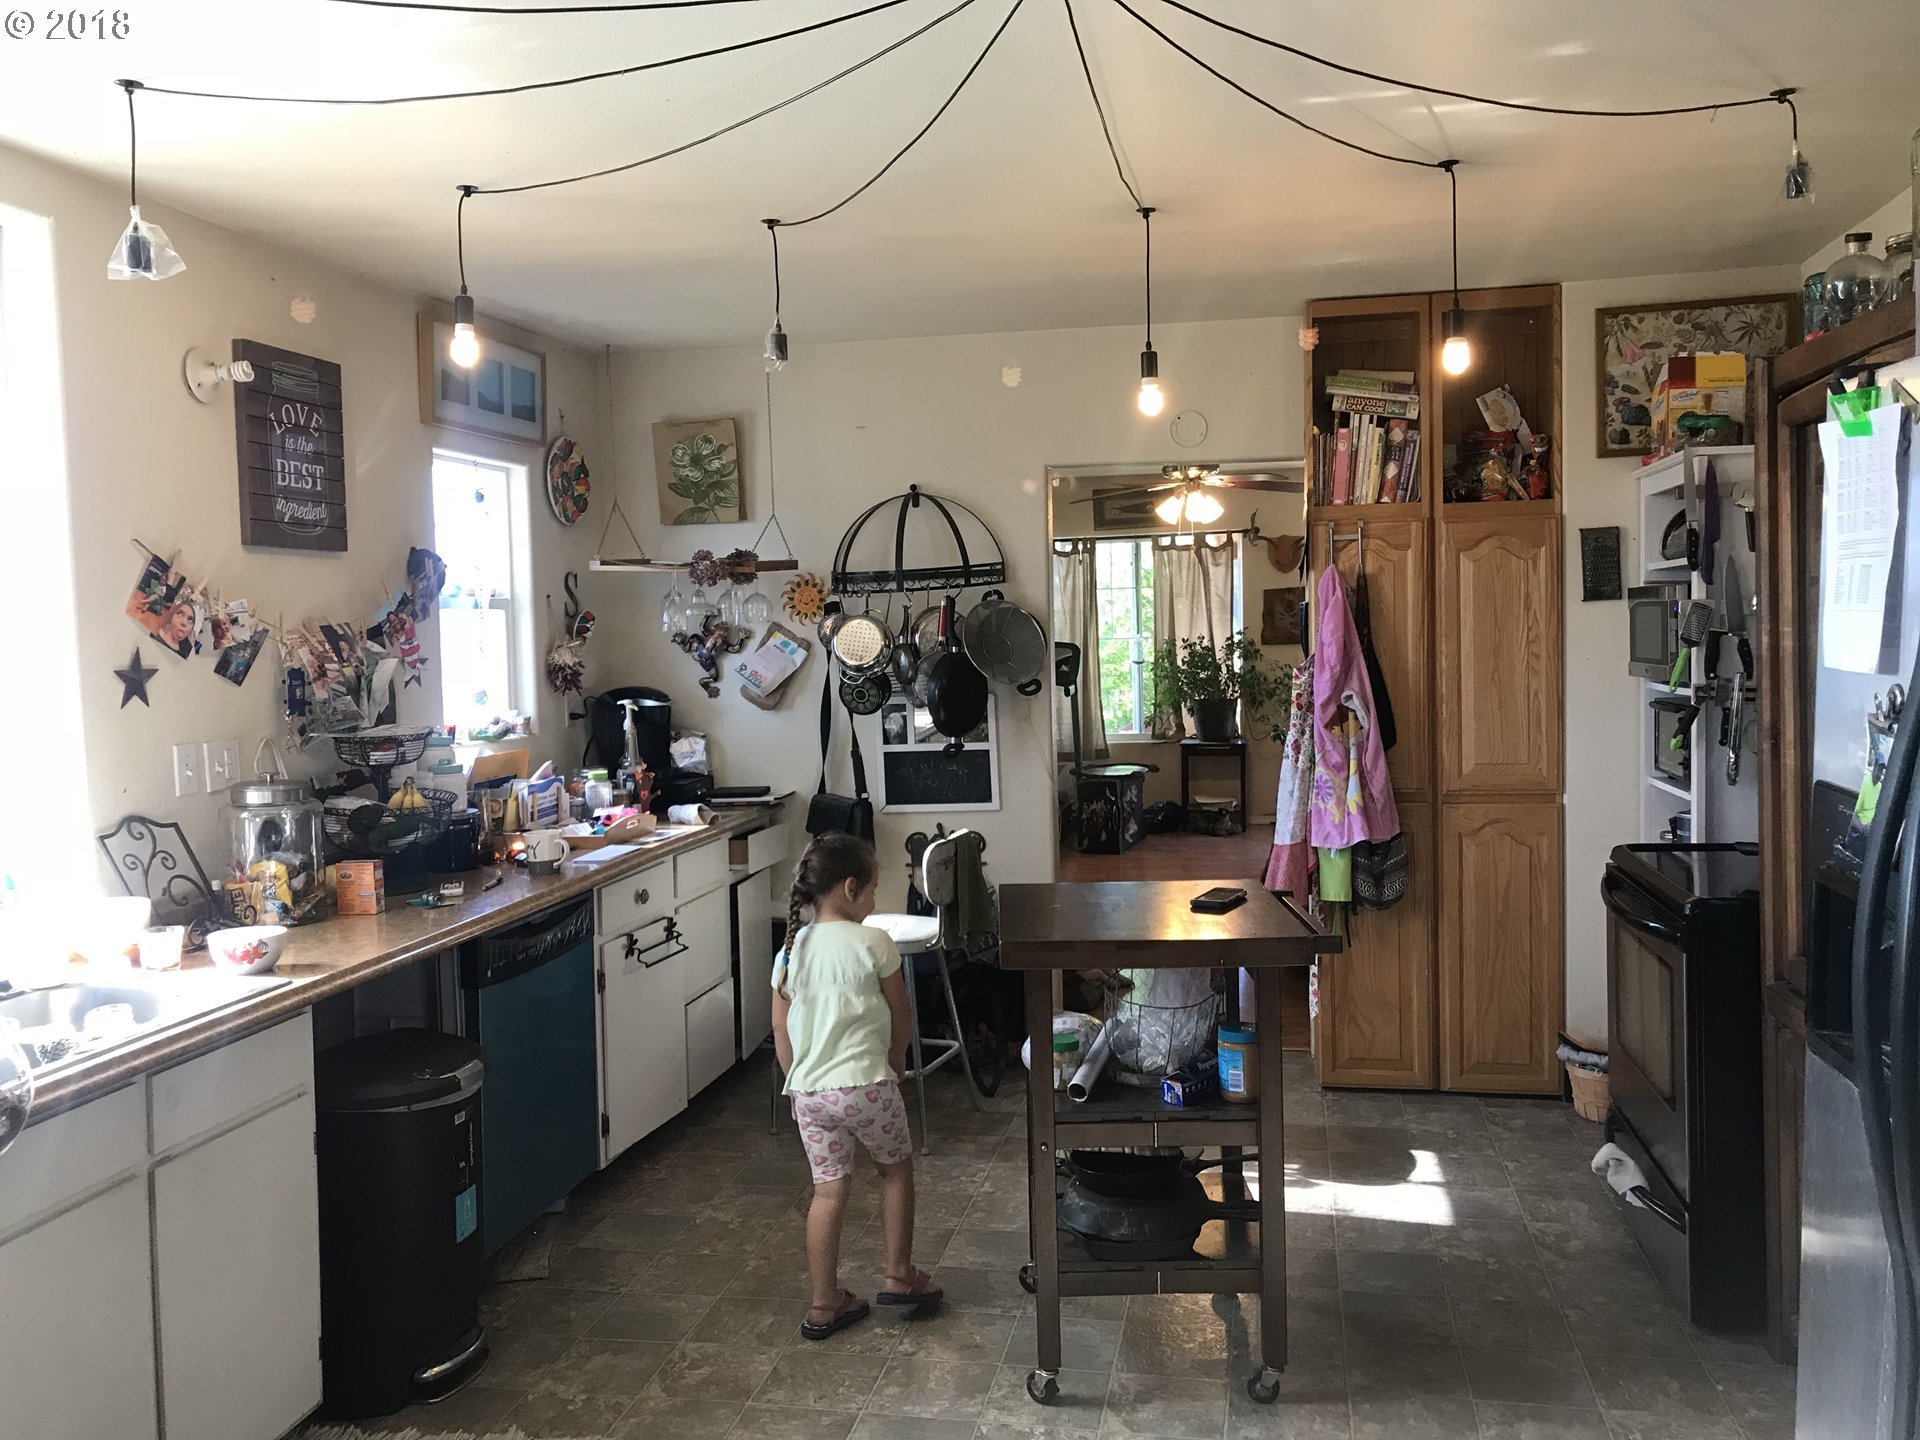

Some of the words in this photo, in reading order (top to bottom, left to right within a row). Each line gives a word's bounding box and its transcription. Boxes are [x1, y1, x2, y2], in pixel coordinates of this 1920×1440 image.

[1346, 403, 1362, 411] CAN
[1364, 405, 1385, 414] COOK
[1347, 396, 1386, 408] anyone
[269, 403, 323, 437] LOVE
[285, 434, 297, 451] is
[297, 435, 314, 456] the
[276, 459, 324, 491] BEST
[276, 495, 328, 522] ingredient
